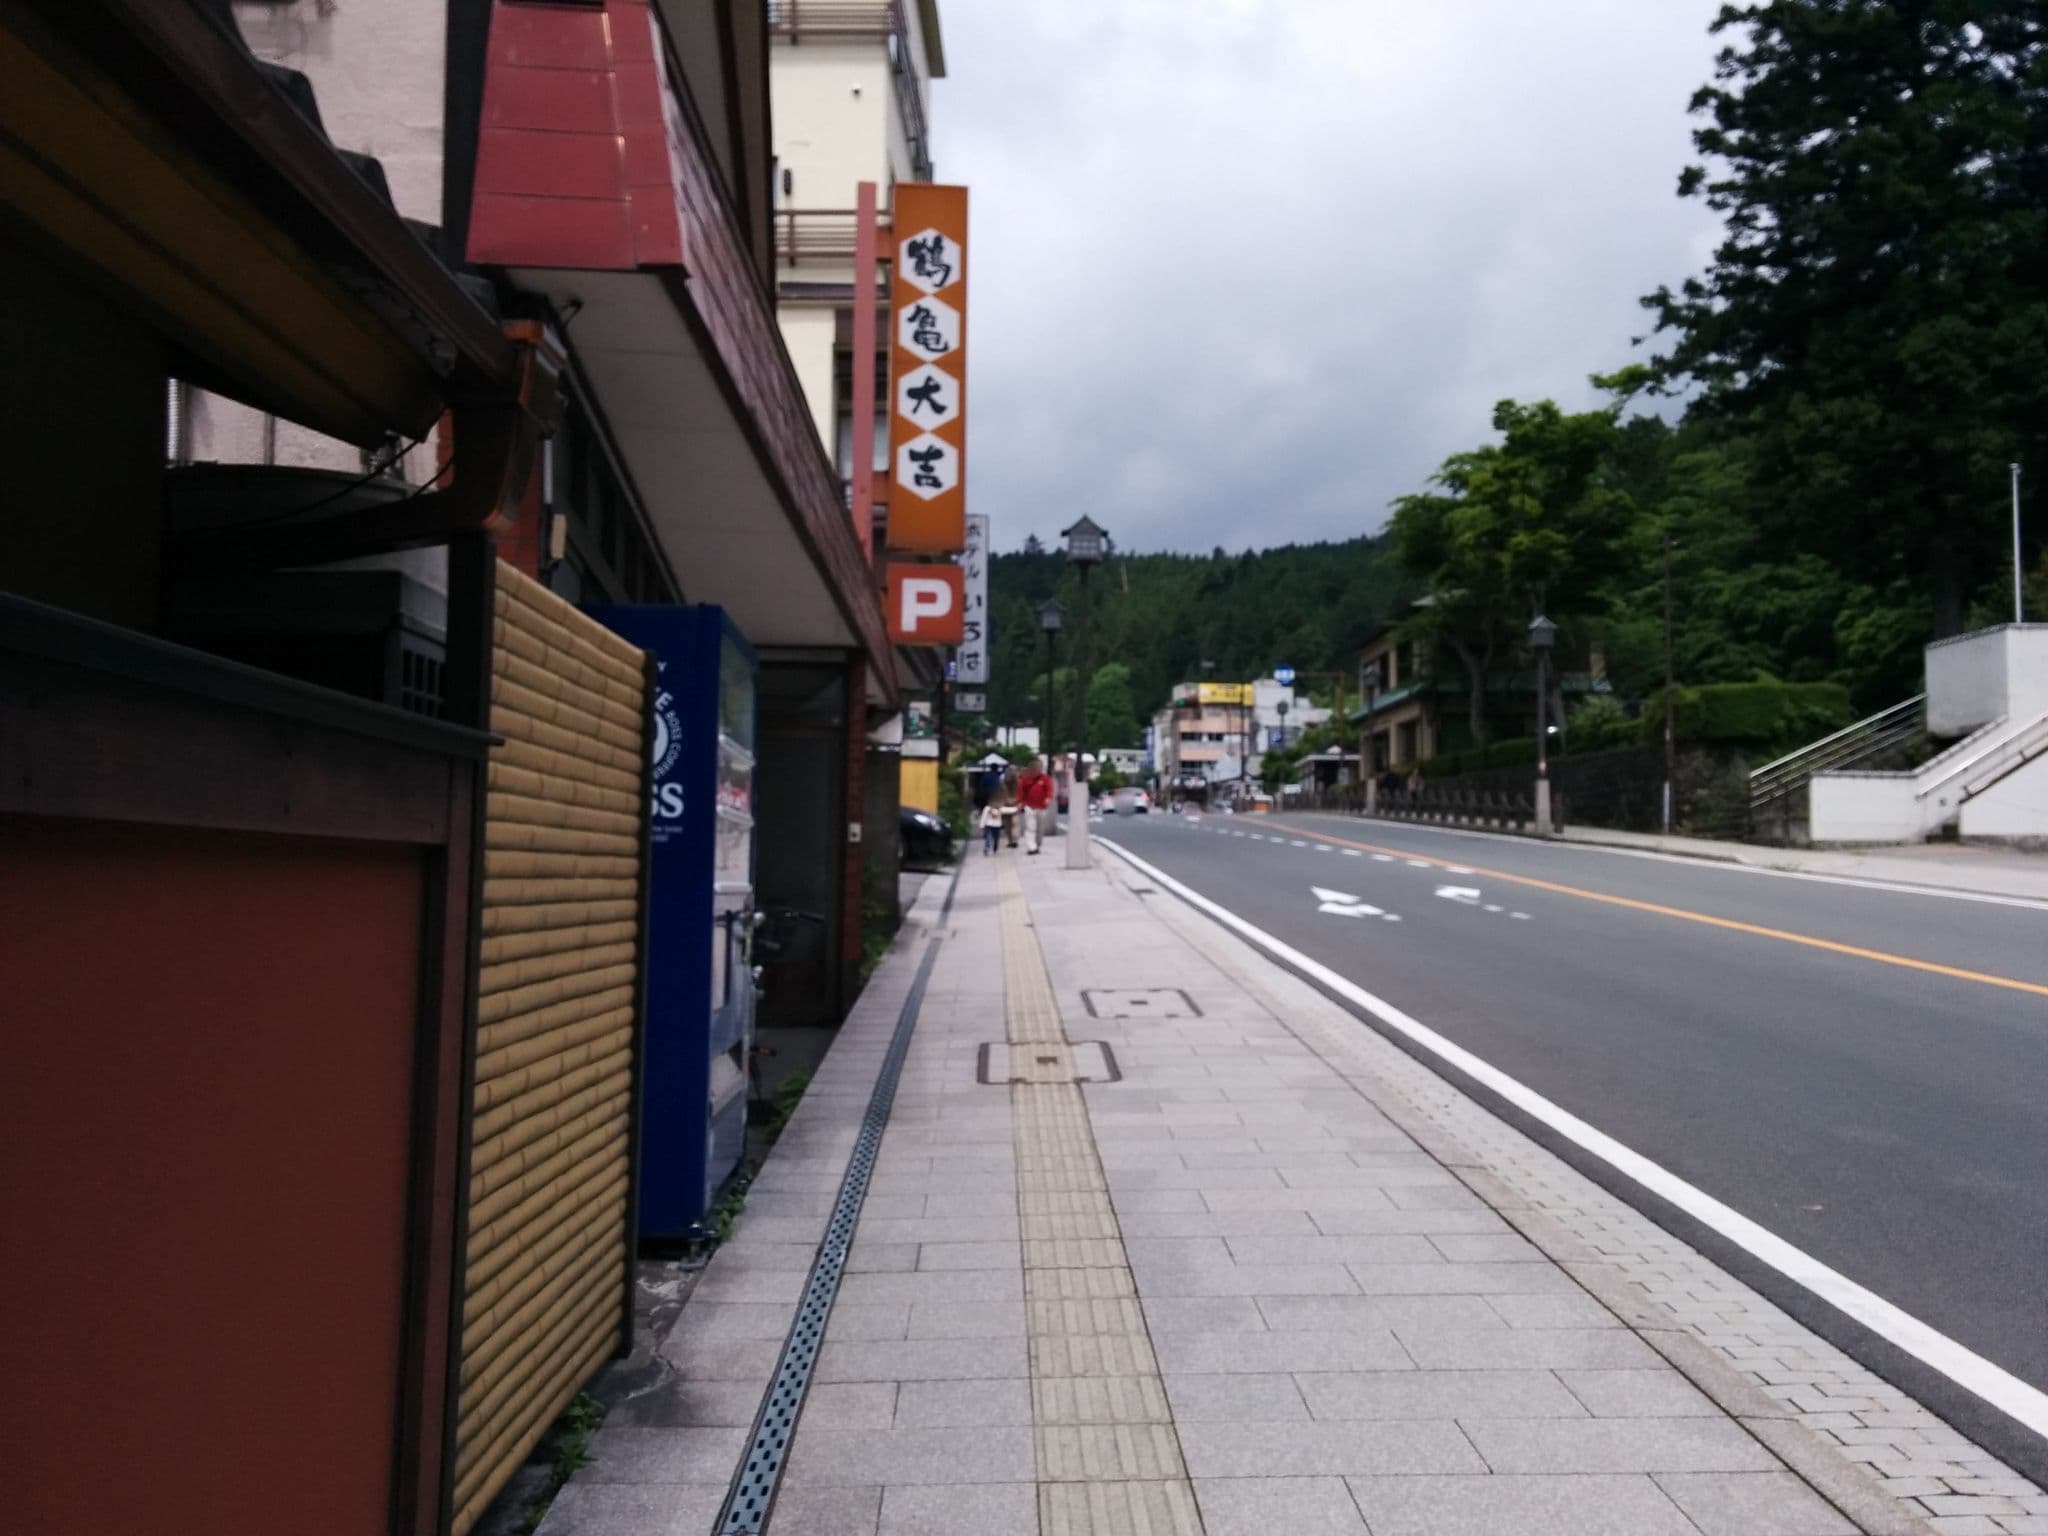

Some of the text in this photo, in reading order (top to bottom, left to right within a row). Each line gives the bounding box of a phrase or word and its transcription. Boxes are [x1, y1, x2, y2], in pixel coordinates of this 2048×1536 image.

[906, 235, 952, 489] 鶴亀大吉
[901, 576, 953, 633] P
